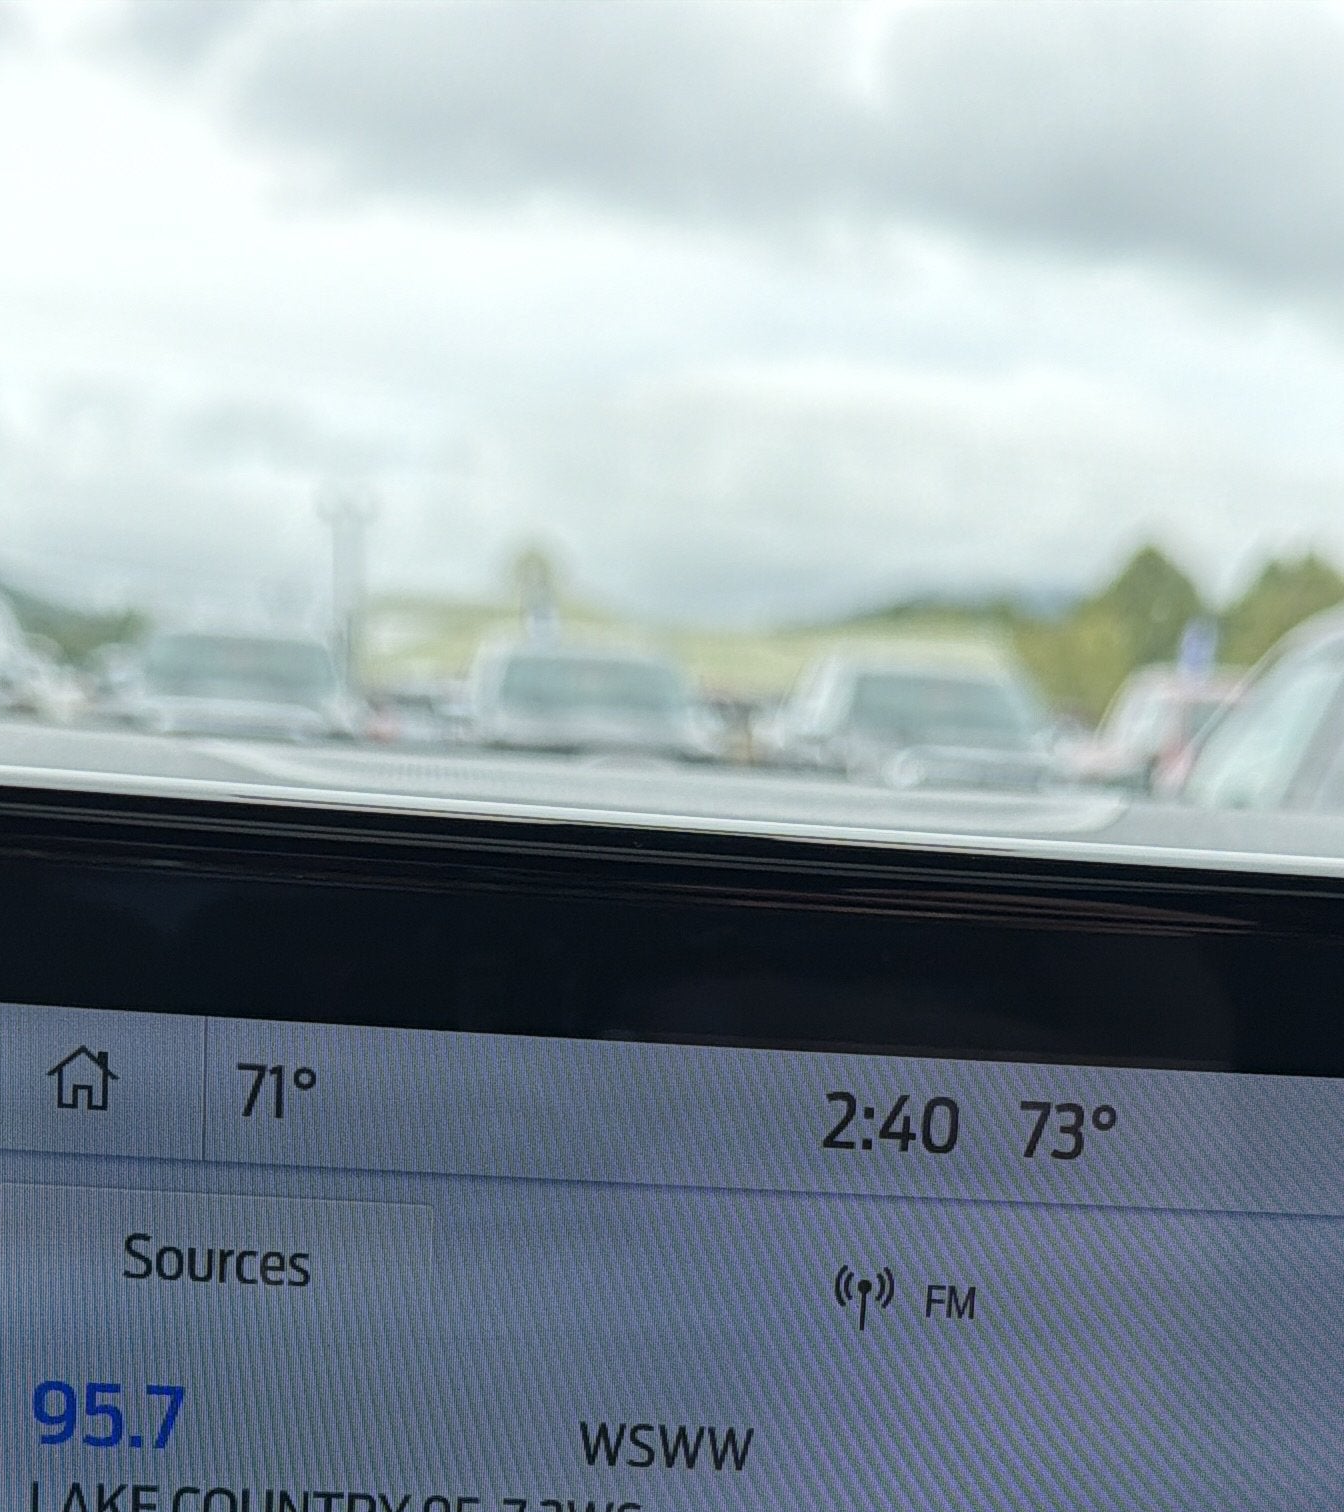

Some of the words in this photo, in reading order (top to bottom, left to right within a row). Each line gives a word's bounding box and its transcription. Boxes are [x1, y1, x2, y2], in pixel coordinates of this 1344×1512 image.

[237, 1062, 317, 1119] 71°
[823, 1092, 960, 1154] 2:40
[1019, 1101, 1118, 1160] 73°
[122, 1233, 312, 1287] Sources
[925, 1284, 977, 1320] FM
[32, 1380, 186, 1450] 95.7
[580, 1422, 755, 1472] WSWW
